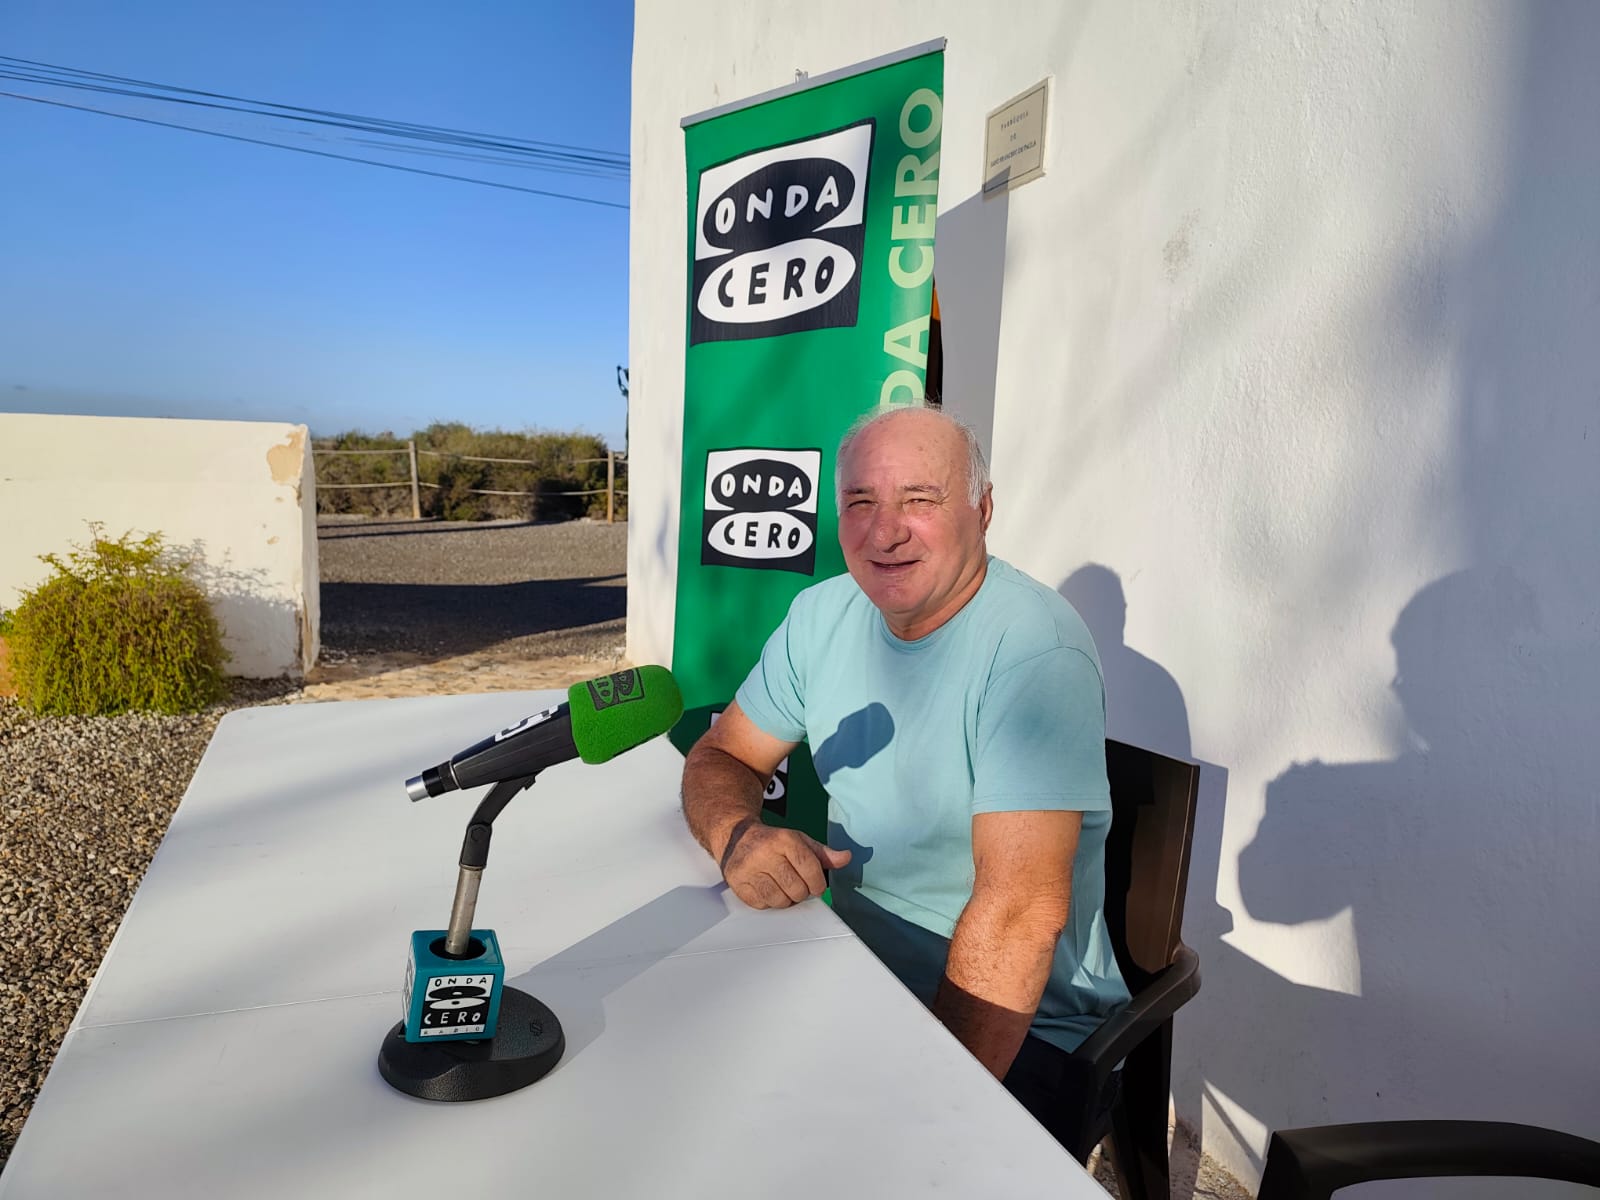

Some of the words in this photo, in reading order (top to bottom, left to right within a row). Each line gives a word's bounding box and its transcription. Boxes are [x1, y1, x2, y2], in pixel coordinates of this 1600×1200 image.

[714, 175, 840, 235] ONDA
[887, 87, 943, 289] CERO
[717, 255, 835, 308] CERO
[879, 314, 931, 414] DA
[720, 473, 803, 499] ONDA
[723, 520, 801, 550] CERO
[434, 976, 487, 987] ONDA
[423, 1011, 481, 1025] CERO
